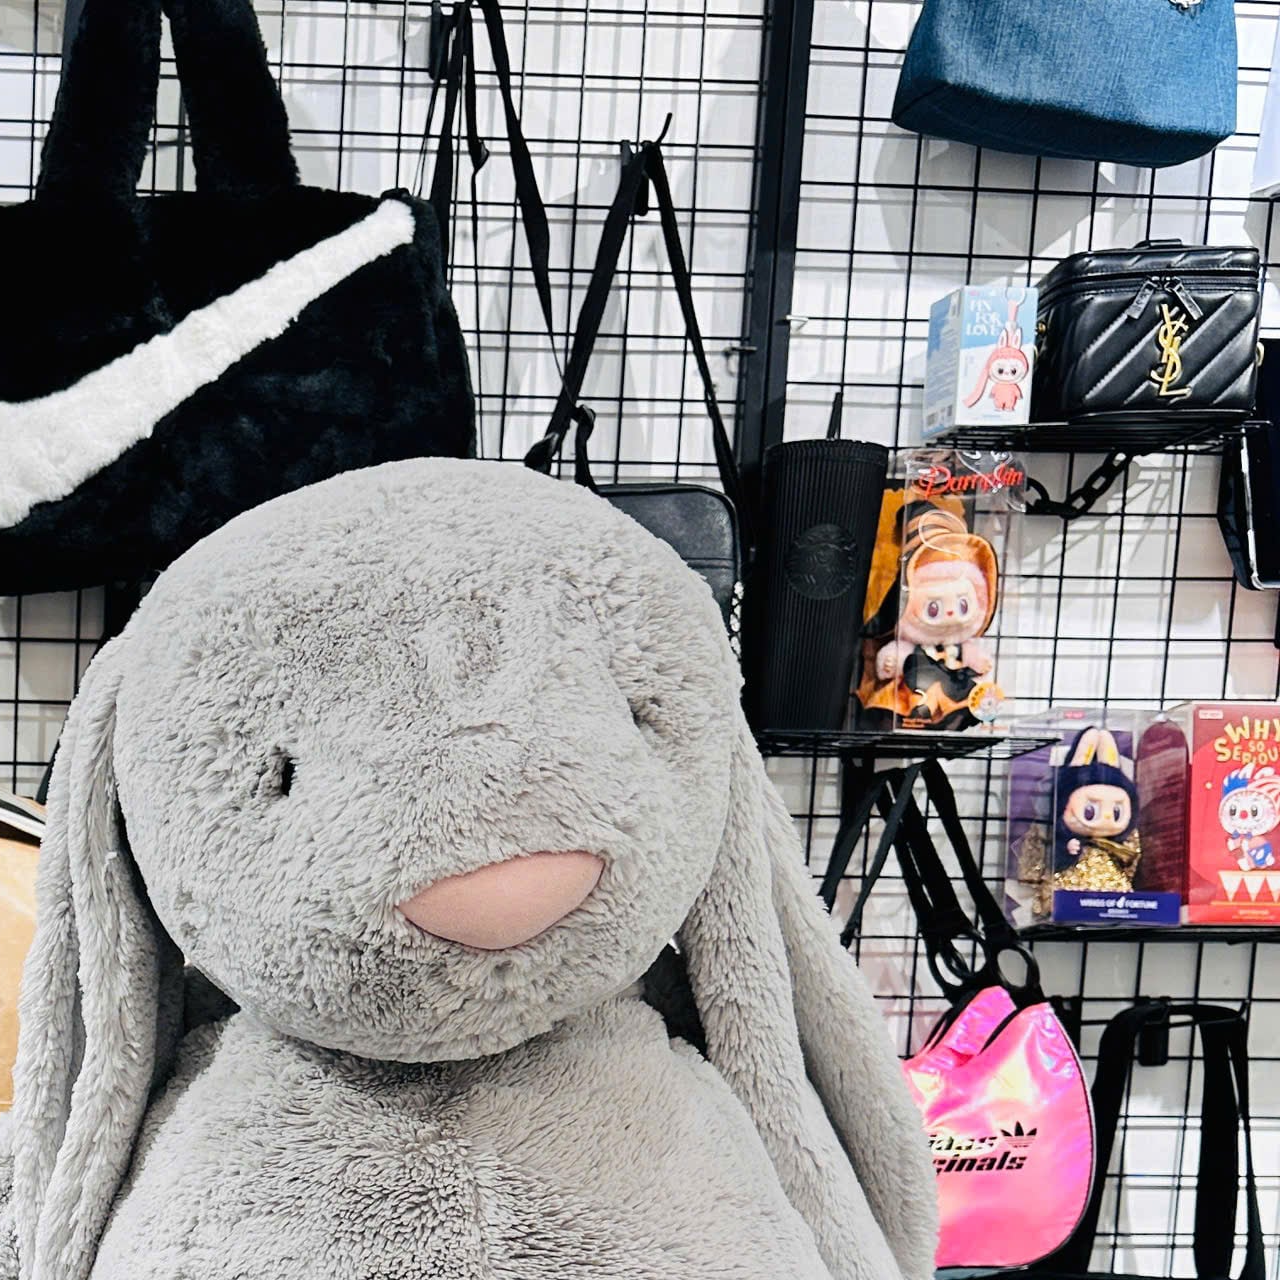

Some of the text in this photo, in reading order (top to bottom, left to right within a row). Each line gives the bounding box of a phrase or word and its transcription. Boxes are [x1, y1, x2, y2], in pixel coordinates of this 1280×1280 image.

[1150, 303, 1192, 396] YSL
[1213, 736, 1279, 766] SERIOU
[1248, 740, 1265, 753] SO
[928, 1134, 998, 1151] idas
[932, 1151, 1028, 1176] ginals
